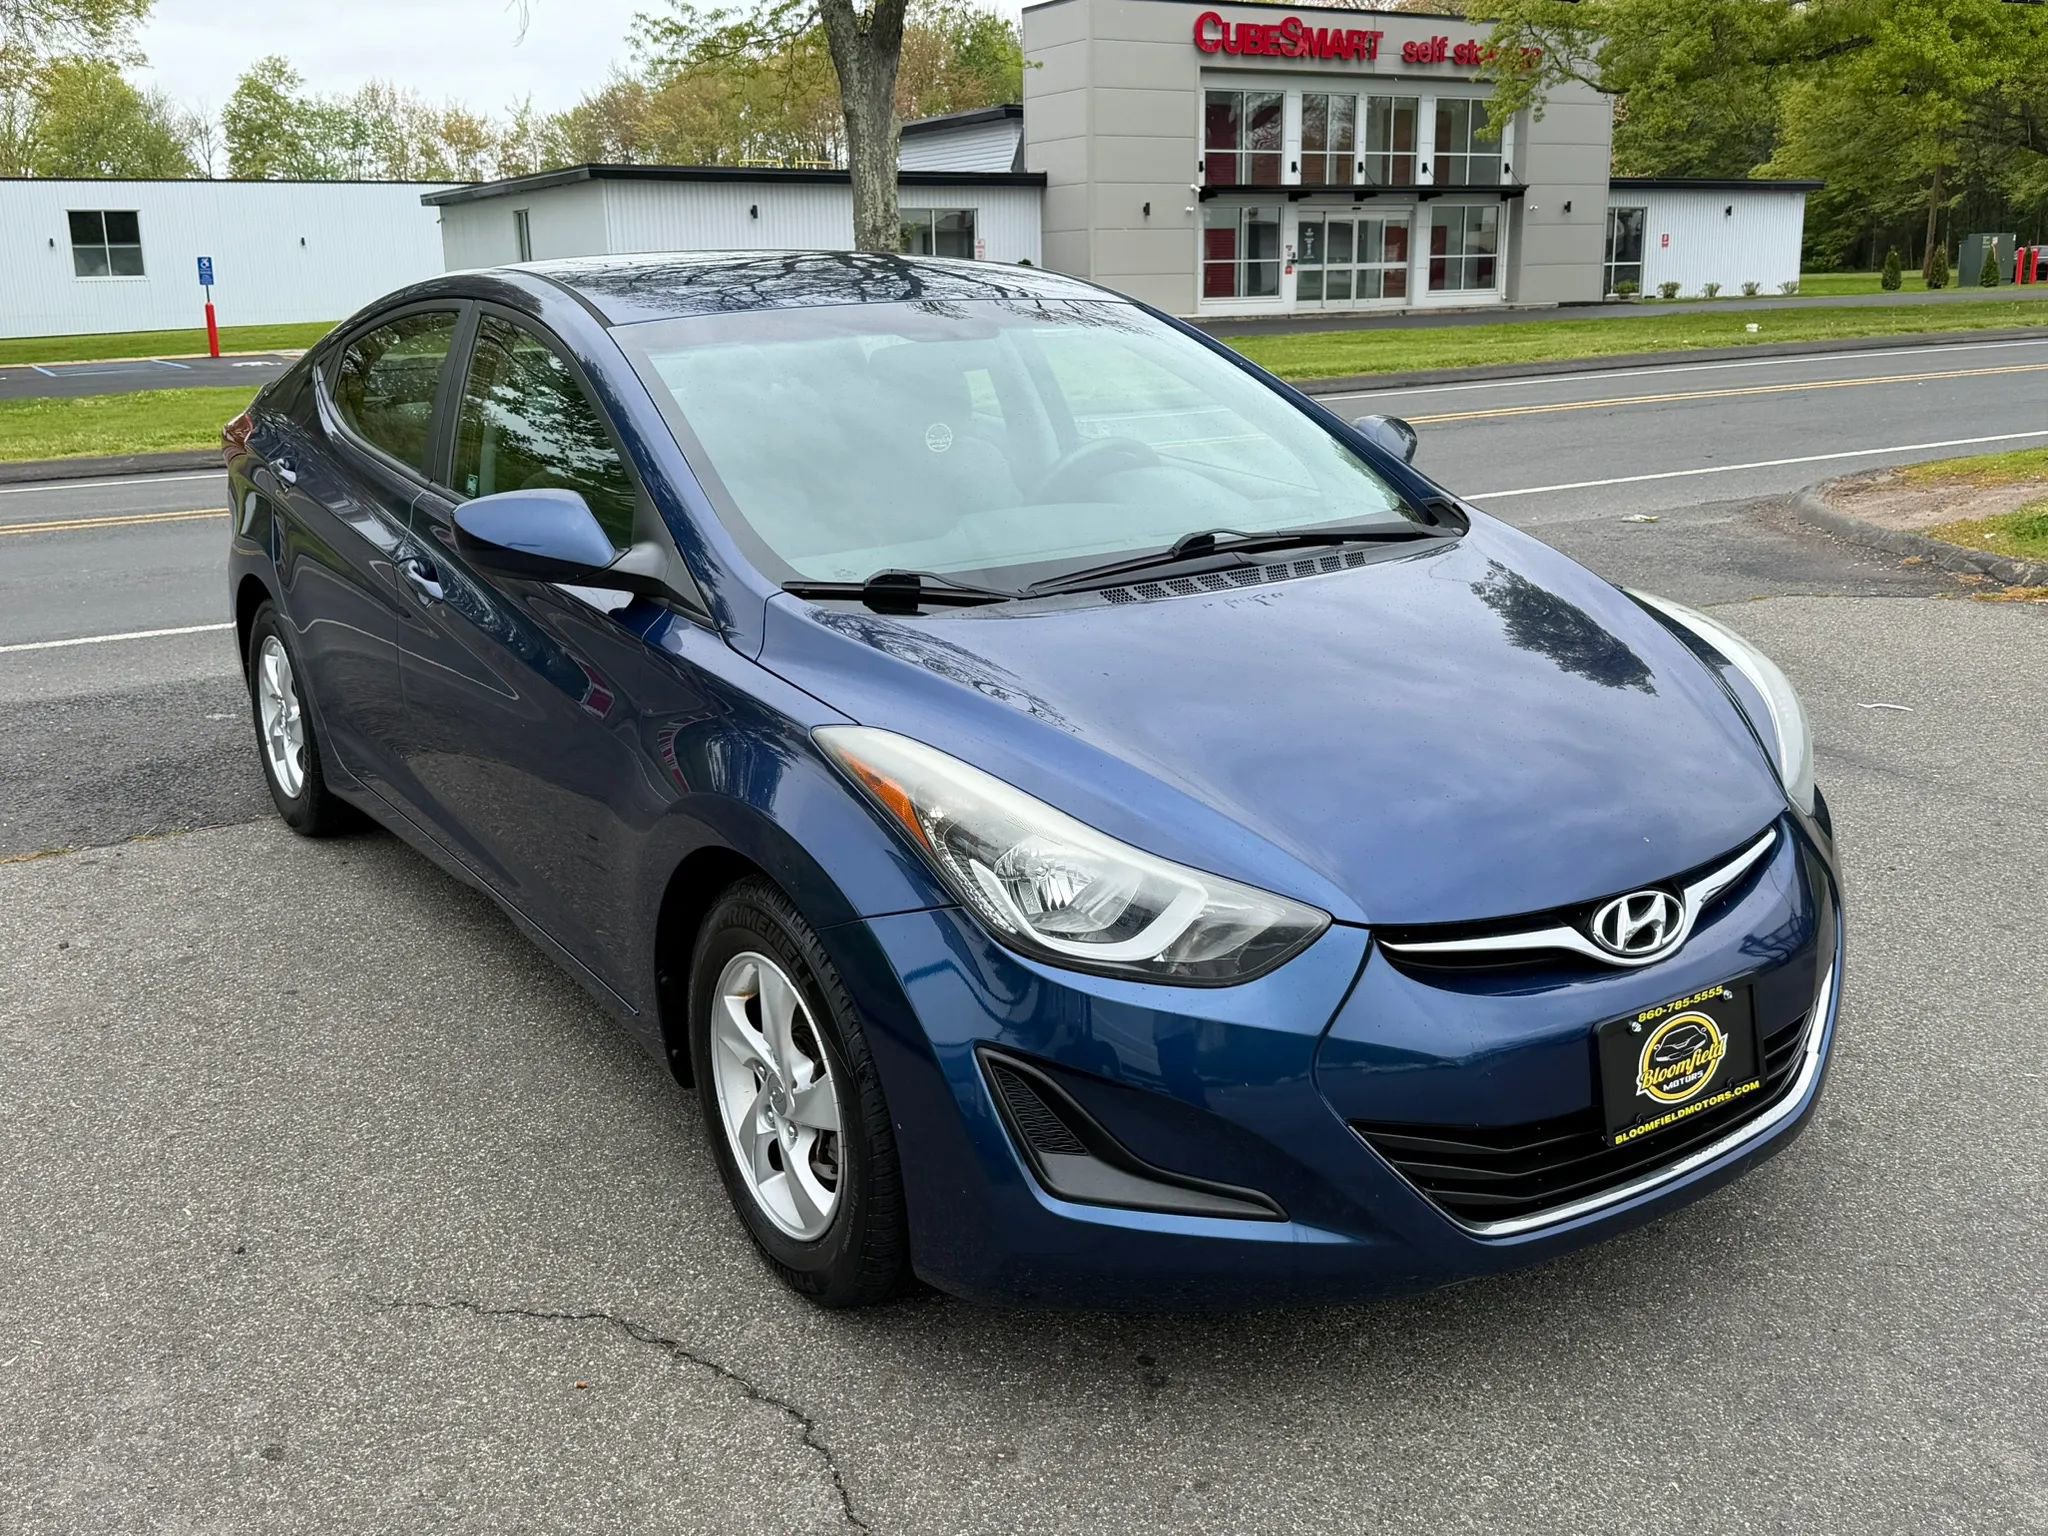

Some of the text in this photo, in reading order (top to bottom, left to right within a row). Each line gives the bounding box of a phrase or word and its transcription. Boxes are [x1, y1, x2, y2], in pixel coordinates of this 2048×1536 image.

[1402, 36, 1449, 64] self
[1638, 985, 1724, 1023] 860-785-5555
[1641, 1039, 1725, 1090] Bloomfield
[1662, 1069, 1704, 1092] MOTORS
[1614, 1080, 1761, 1145] BLOOMFIELDMOTORS.COM
